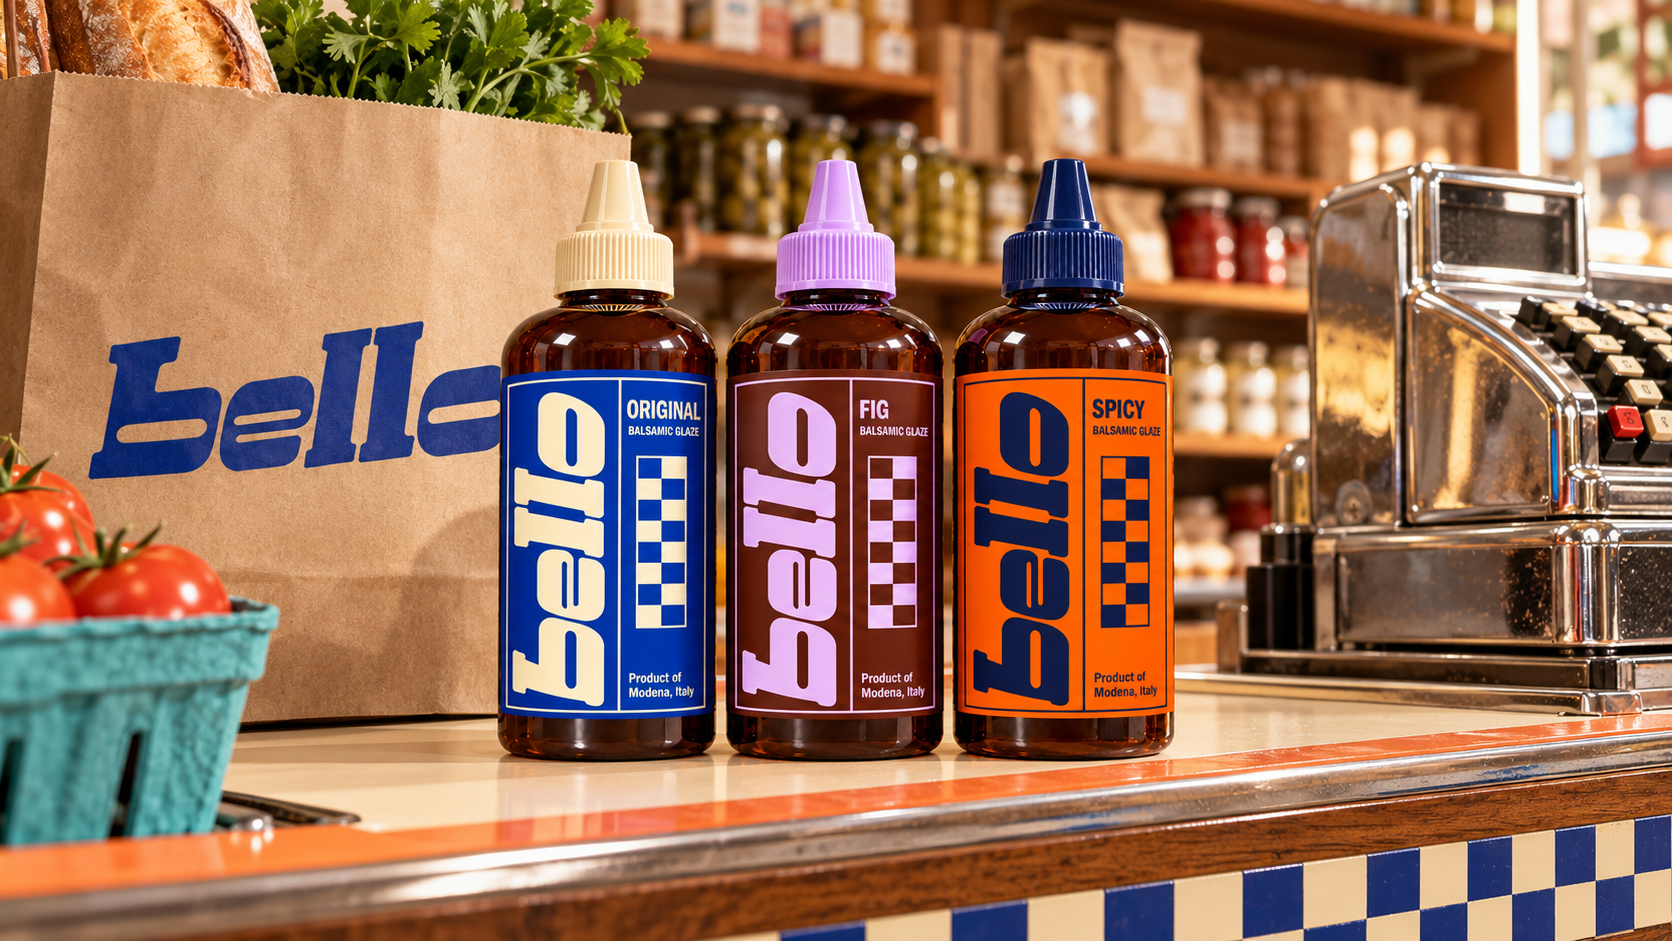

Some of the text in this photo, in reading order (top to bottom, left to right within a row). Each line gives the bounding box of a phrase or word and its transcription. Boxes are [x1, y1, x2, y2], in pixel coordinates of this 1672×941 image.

[89, 321, 500, 479] bello
[626, 399, 701, 421] ORIGINAL
[859, 399, 889, 420] FIG
[1092, 398, 1145, 419] SPICY
[628, 425, 700, 437] BALSAMIC GLAZE
[859, 426, 929, 437] BALSAMIC GLAZE
[1092, 425, 1161, 437] BALSAMIC GLAZE
[512, 391, 606, 707] bello
[742, 391, 837, 707] bello
[973, 391, 1070, 707] bello
[628, 671, 682, 684] Product of
[861, 671, 914, 684] Product of
[1094, 670, 1146, 684] Product of
[628, 685, 695, 699] Modena, Italy
[861, 686, 926, 699] Modena, Italy
[1094, 685, 1158, 699] Modena, Italy
